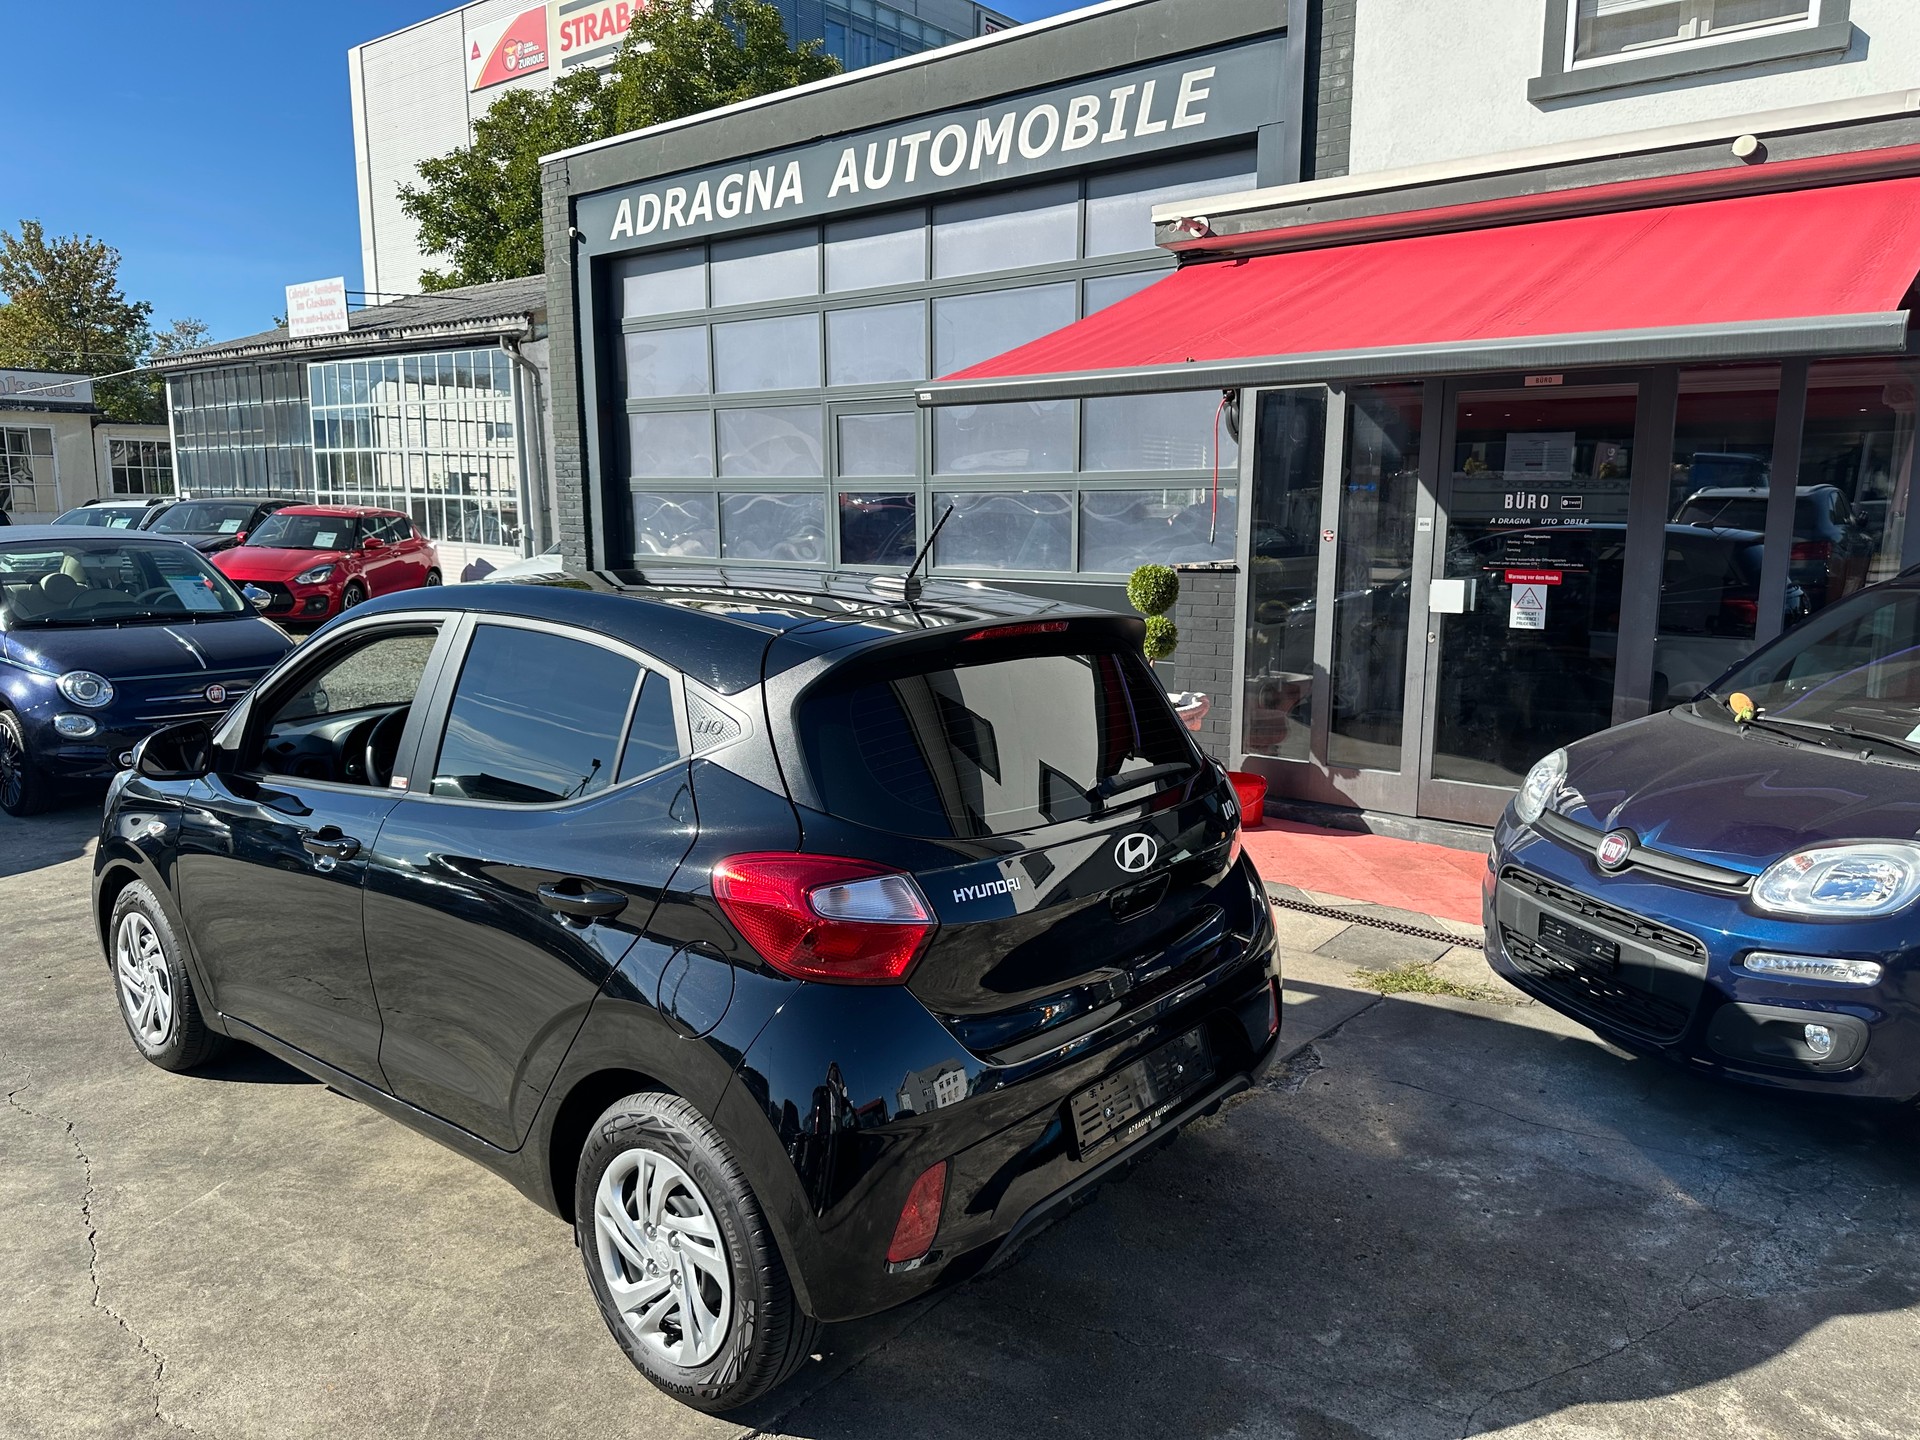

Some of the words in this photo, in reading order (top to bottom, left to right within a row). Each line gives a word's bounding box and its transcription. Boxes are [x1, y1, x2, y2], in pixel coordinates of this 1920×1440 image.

[560, 0, 648, 51] STRAB
[518, 52, 545, 69] ZURIQUE
[609, 161, 804, 240] ADRAGNA
[827, 66, 1216, 198] AUTOMOBILE
[0, 376, 75, 398] kauf
[1535, 376, 1553, 384] BÜRO
[1504, 491, 1549, 509] BÜRO
[1603, 841, 1621, 858] FIAT
[952, 877, 1021, 903] HYUNDAI
[1128, 1115, 1152, 1135] ADRAGNA
[693, 1160, 748, 1270] Continental
